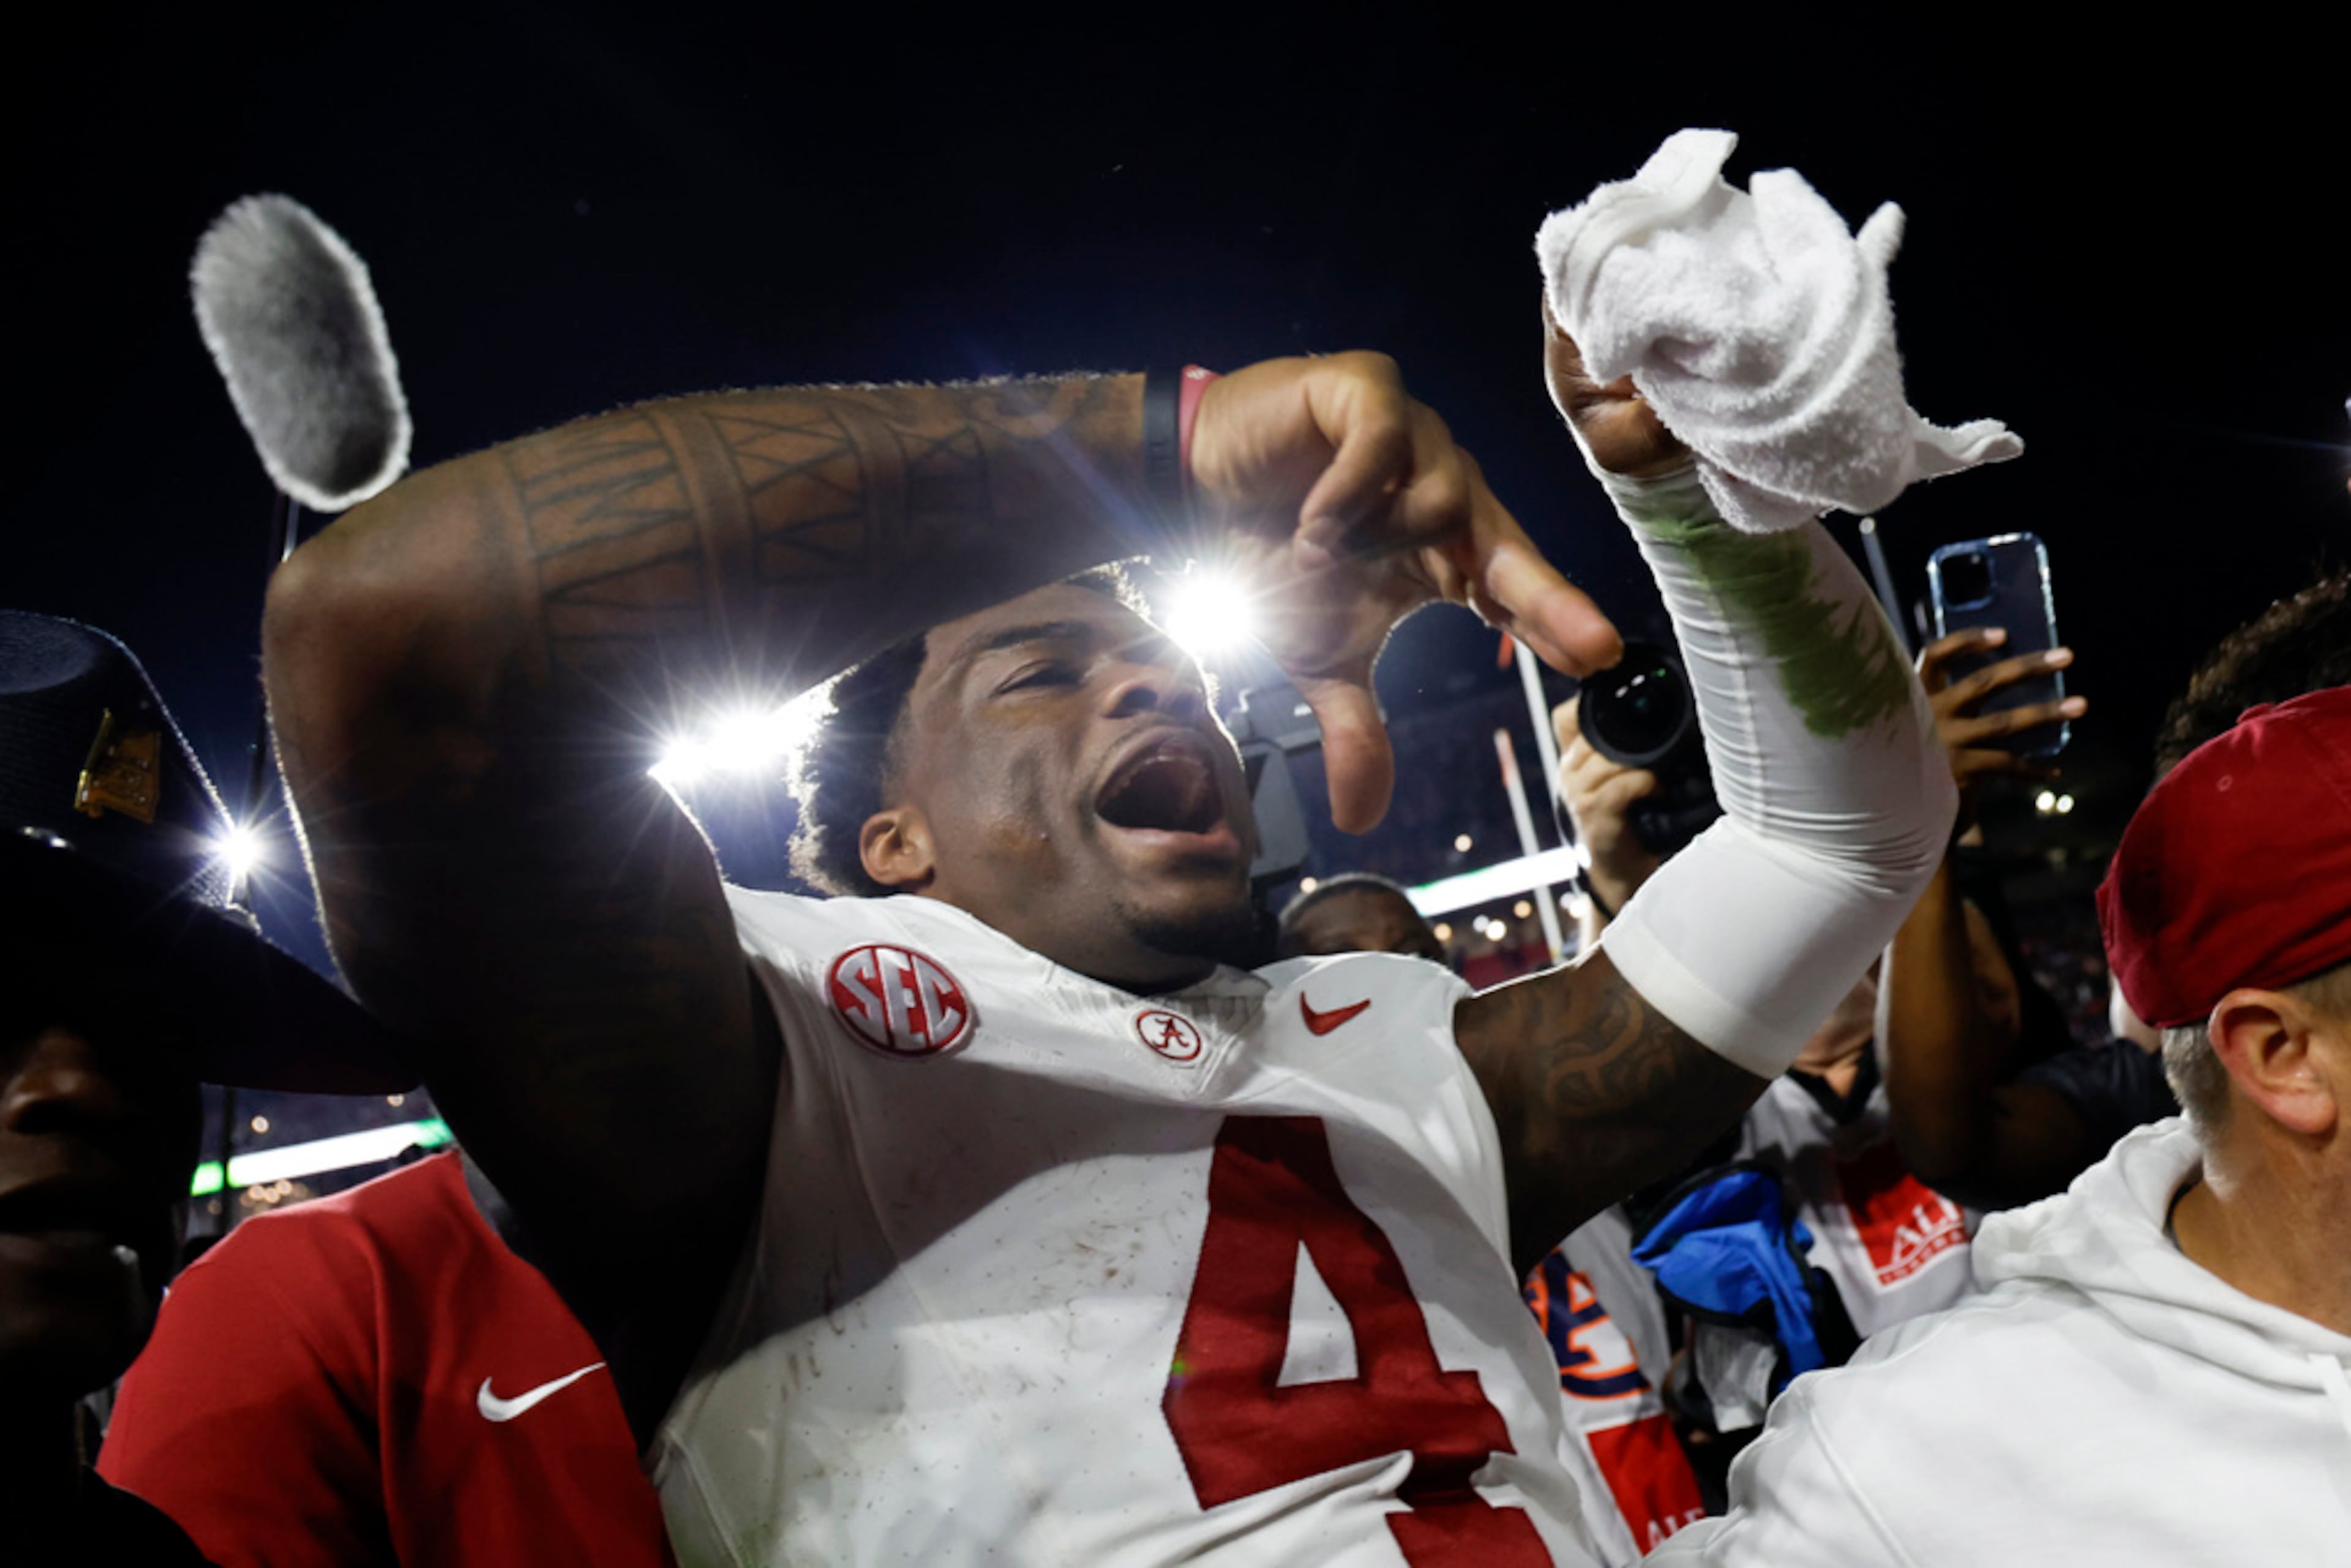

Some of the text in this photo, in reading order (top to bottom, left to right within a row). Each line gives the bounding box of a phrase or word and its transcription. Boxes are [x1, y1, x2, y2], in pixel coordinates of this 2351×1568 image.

[835, 947, 966, 1051] SEC
[1152, 1018, 1190, 1049] A
[1161, 1115, 1556, 1568] 4
